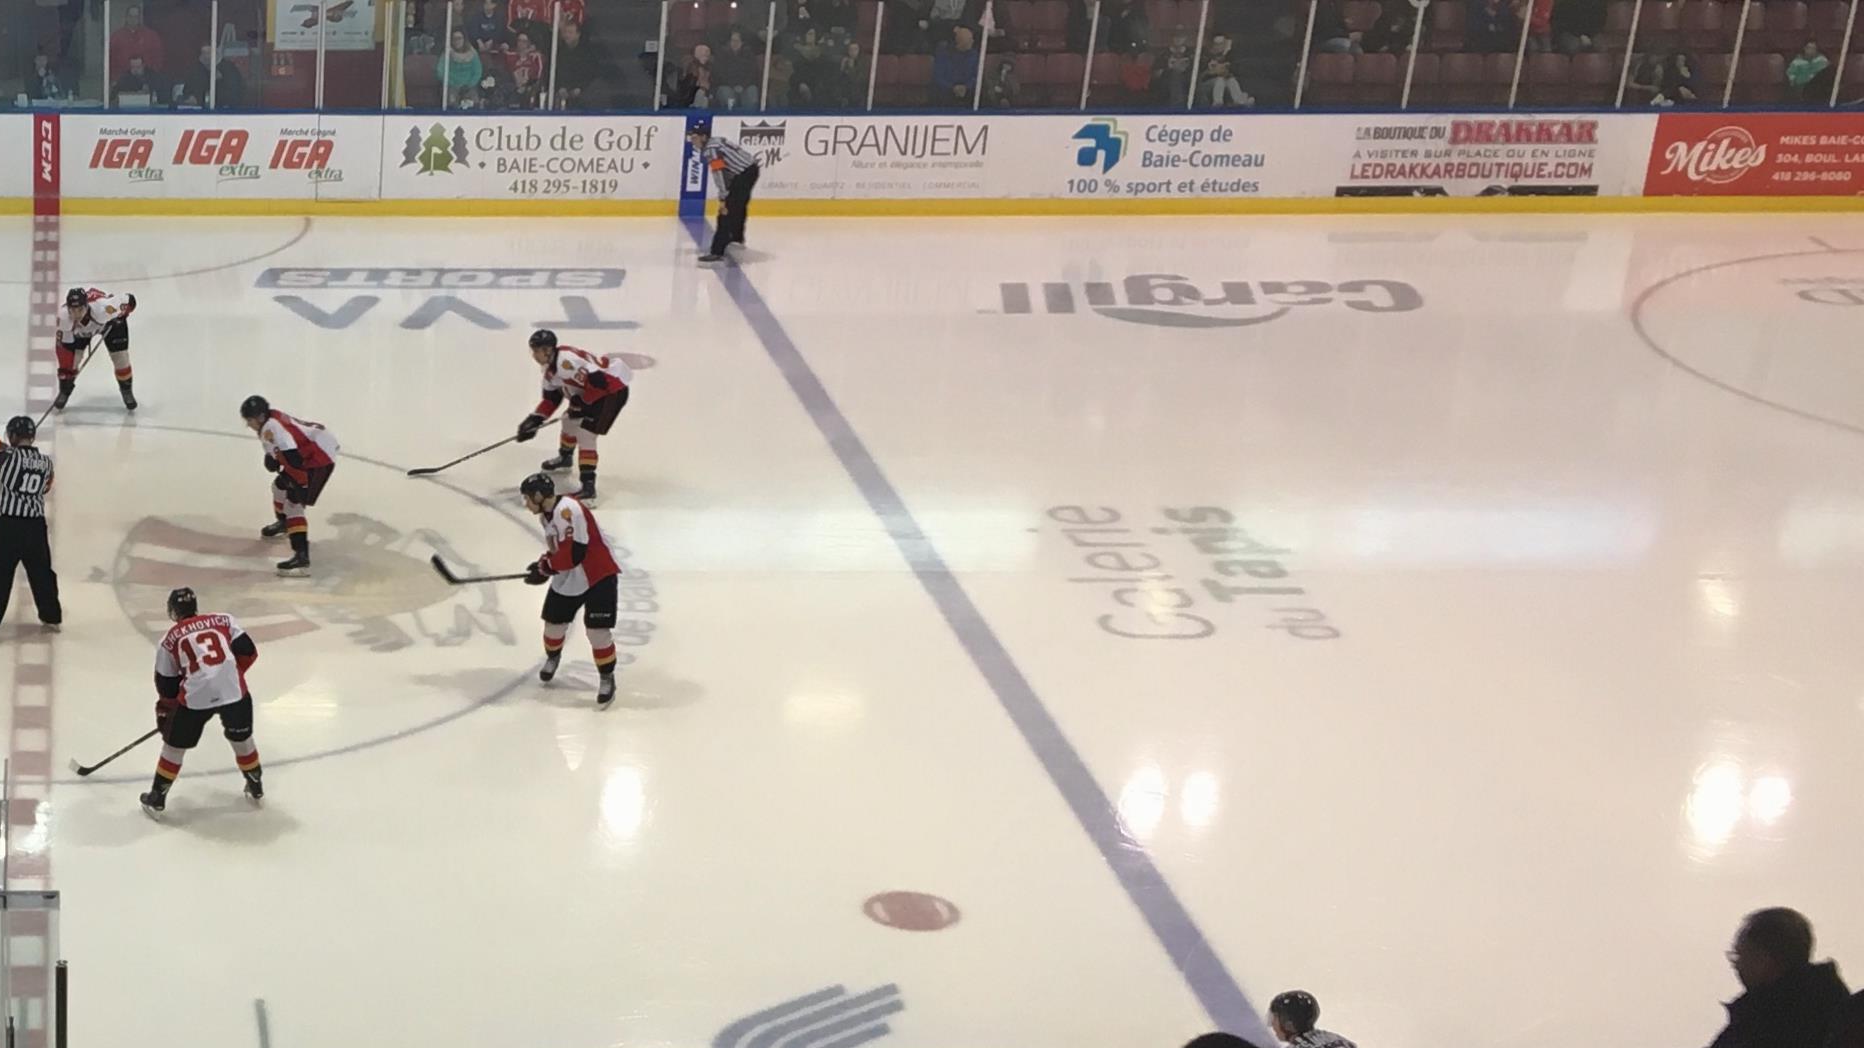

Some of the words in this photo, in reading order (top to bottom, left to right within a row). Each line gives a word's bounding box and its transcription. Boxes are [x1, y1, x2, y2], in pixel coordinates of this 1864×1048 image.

[99, 128, 128, 136] Marché
[130, 128, 156, 137] Gagné
[280, 128, 309, 136] Marché
[311, 128, 336, 137] Gagné
[474, 125, 541, 152] Club
[549, 126, 584, 151] de
[593, 125, 659, 152] Golf
[803, 124, 989, 159] GRANIJEM
[1145, 124, 1204, 147] Cégep
[1210, 125, 1233, 143] de
[1373, 126, 1429, 140] BOUTIQUE
[1429, 126, 1446, 140] DU
[1448, 120, 1599, 145] DRAKKAR
[1780, 135, 1816, 145] MIKES
[41, 120, 52, 182] CCM
[88, 138, 154, 169] IGA
[172, 130, 249, 165] IGA
[268, 139, 334, 169] IGA
[1367, 149, 1418, 159] VISITER
[1424, 149, 1453, 159] SUR
[1457, 149, 1499, 159] PLACE
[1506, 149, 1526, 159] OU
[1532, 149, 1549, 159] EN
[1554, 149, 1595, 159] LIGNE
[497, 157, 634, 174] BAIE-COMEAU
[1141, 150, 1265, 168] Baie-Comeau
[1660, 137, 1767, 180] Mikes
[1776, 153, 1802, 164] 304,
[128, 166, 164, 182] extra
[218, 163, 260, 180] extra
[308, 166, 343, 182] extra
[1350, 162, 1594, 182] LEDRAKKARBOUTIQUE.COM
[1772, 171, 1791, 181] 418
[509, 179, 538, 194] 418
[542, 178, 618, 194] 295-1819
[1067, 179, 1098, 193] 100
[1104, 179, 1120, 193] %
[1126, 179, 1171, 196] sport
[1177, 180, 1194, 193] et
[1200, 178, 1260, 193] études
[276, 270, 606, 288] SPORTS
[999, 274, 1424, 314] Cargill
[272, 295, 642, 330] TVA
[19, 472, 42, 494] 10
[1149, 505, 1306, 605] Tapis
[162, 615, 231, 651] CHEKHOVICH
[179, 630, 227, 674] 13
